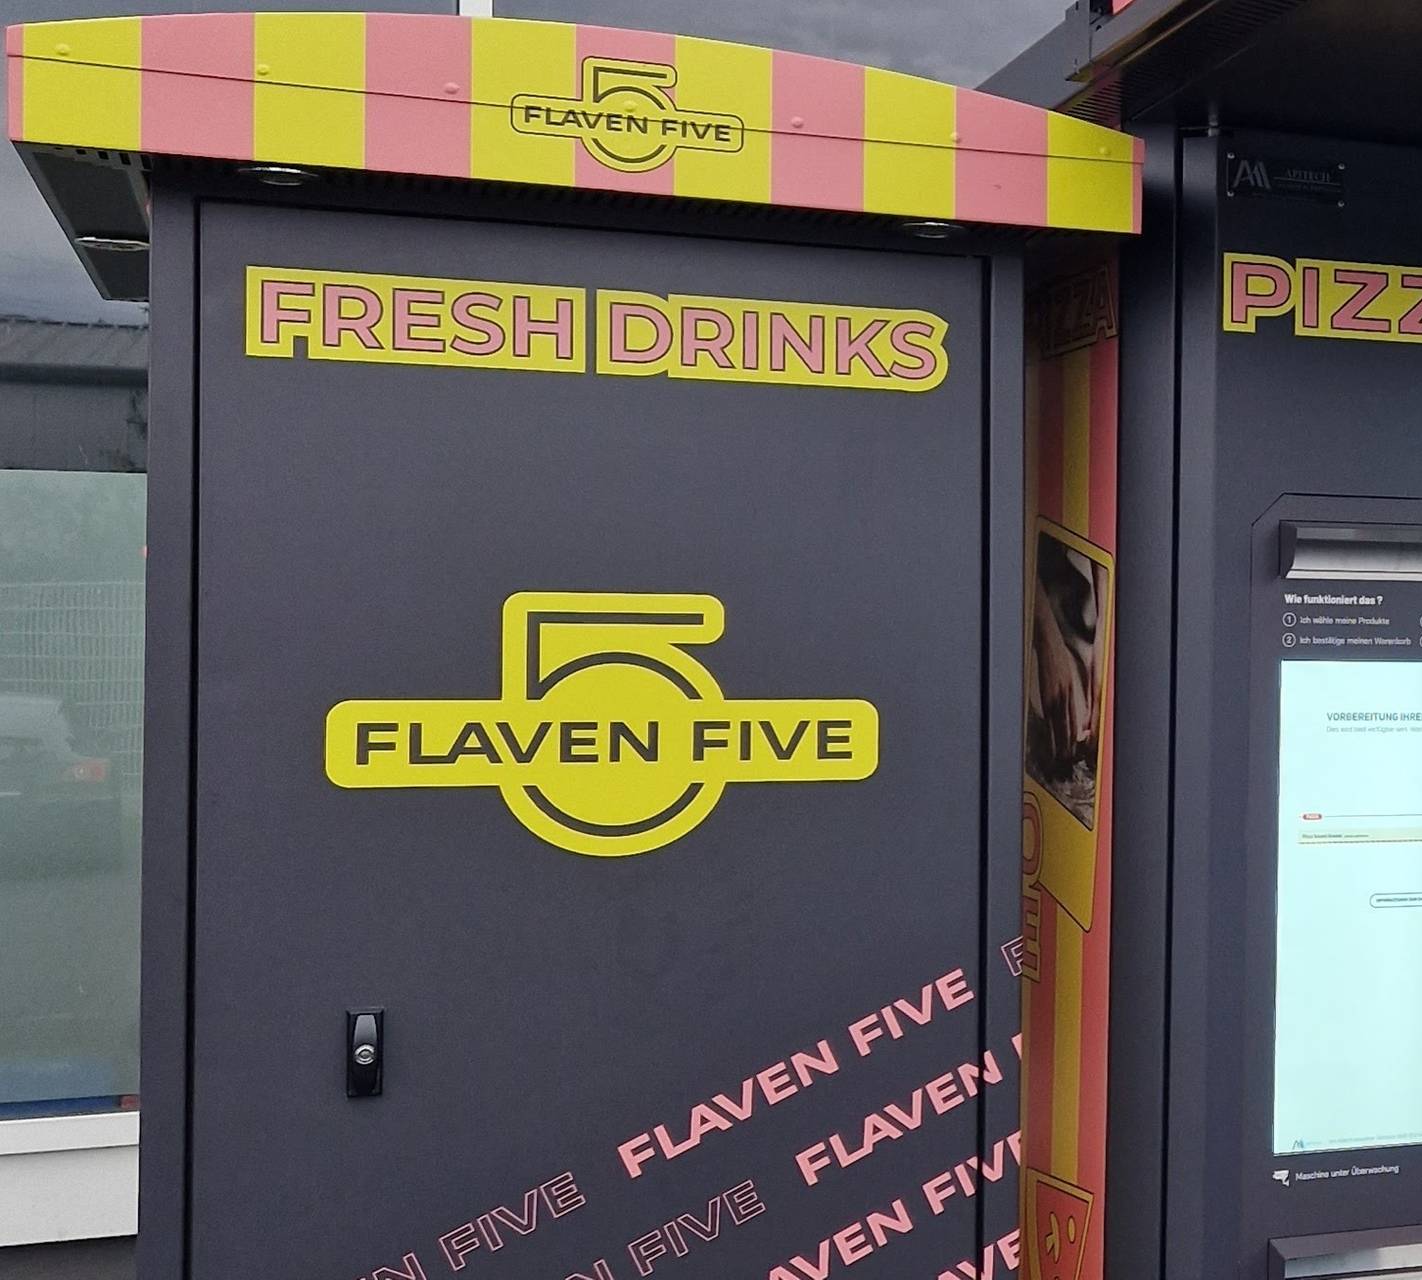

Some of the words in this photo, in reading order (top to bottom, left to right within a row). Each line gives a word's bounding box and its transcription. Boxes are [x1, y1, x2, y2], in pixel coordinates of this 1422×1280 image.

[523, 104, 648, 135] FLAVEN
[661, 118, 733, 142] FIVE
[260, 279, 574, 360] FRESH
[610, 301, 937, 381] DRINKS
[1284, 593, 1303, 604] Wie
[1303, 594, 1358, 605] funktioniert
[1359, 595, 1376, 605] das
[1377, 595, 1383, 605] ?
[1335, 617, 1357, 625] meine
[1358, 617, 1390, 626] Produkte
[1346, 637, 1373, 646] meinen
[1374, 637, 1411, 646] Warenkorb
[1326, 712, 1399, 721] VORBEREITUNG
[355, 719, 661, 766] FLAVEN
[692, 718, 854, 762] FIVE
[438, 1171, 587, 1272] FIVE
[616, 1039, 839, 1179] FLAVEN
[847, 967, 975, 1057] FIVE
[627, 1179, 767, 1277] FIVE
[794, 1050, 1004, 1187] FLAVEN
[1295, 1170, 1329, 1181] Maschine
[1331, 1168, 1350, 1178] unter
[1351, 1165, 1400, 1177] Überwachung
